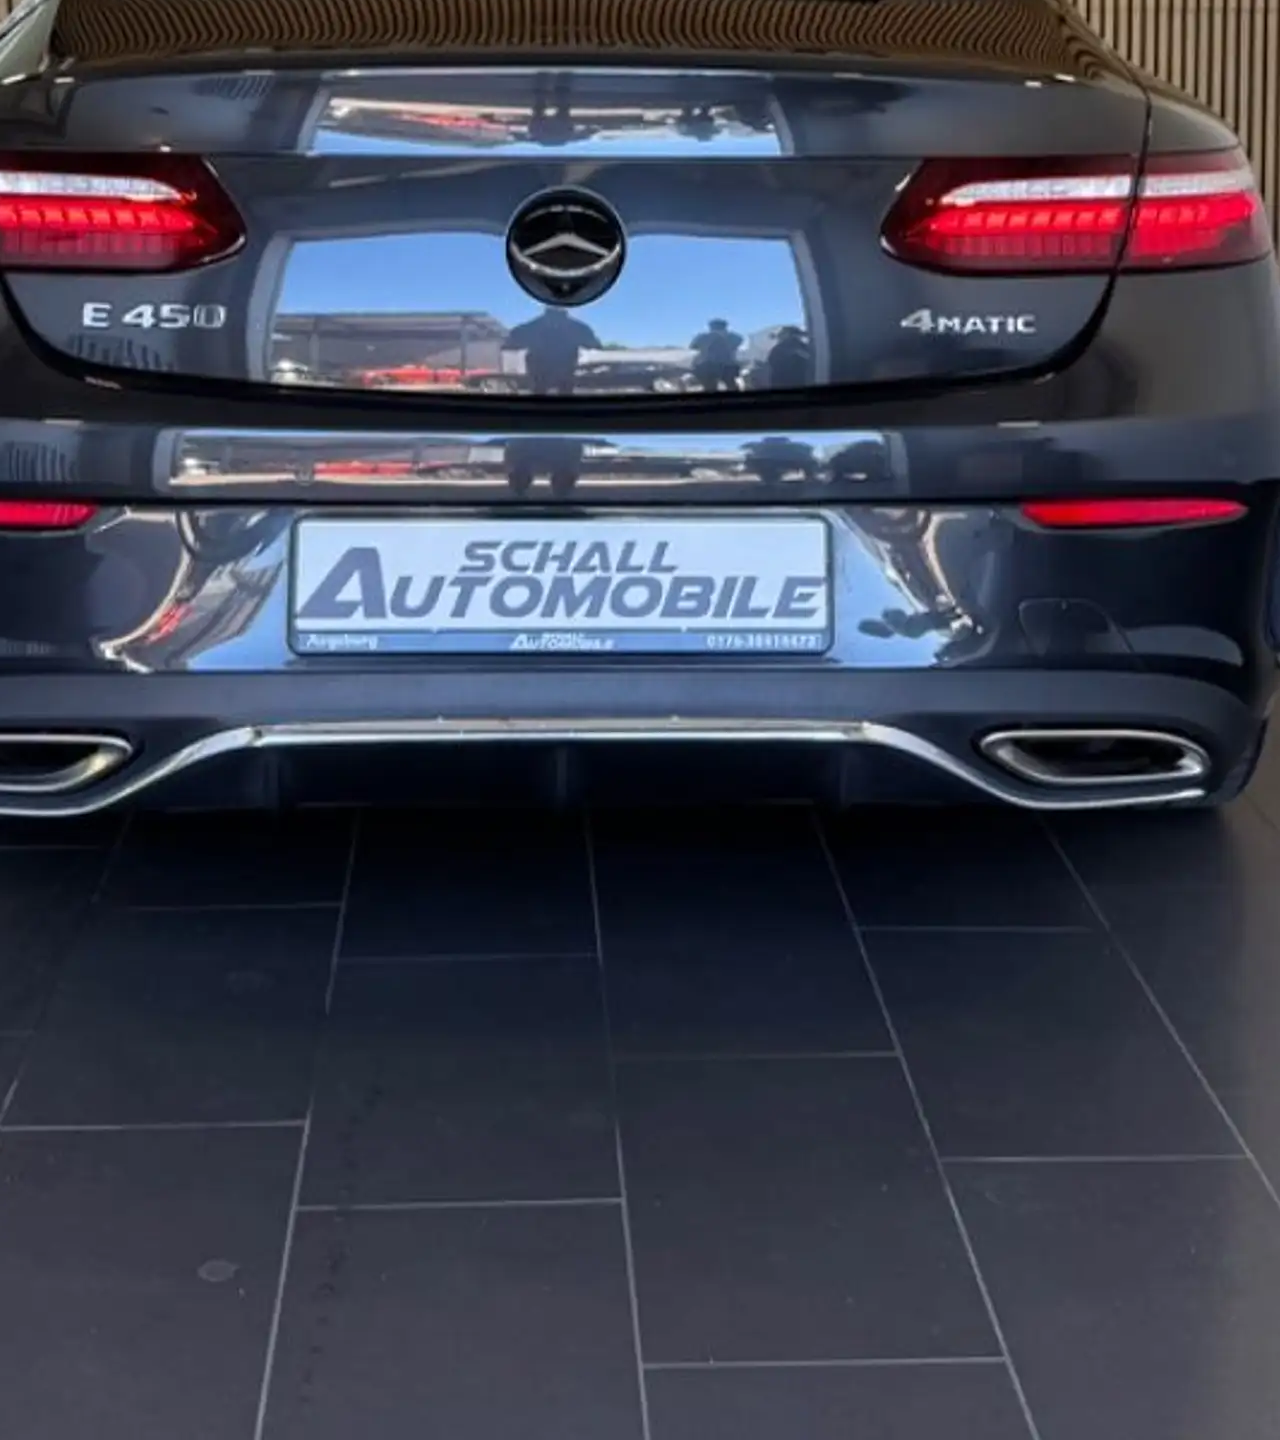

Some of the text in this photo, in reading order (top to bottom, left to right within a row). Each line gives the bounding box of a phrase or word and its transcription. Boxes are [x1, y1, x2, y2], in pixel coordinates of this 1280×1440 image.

[83, 301, 227, 329] E 450
[900, 308, 1036, 334] 4MATIC
[458, 540, 677, 574] SCHALL
[297, 546, 827, 620] AUTOMOBILE
